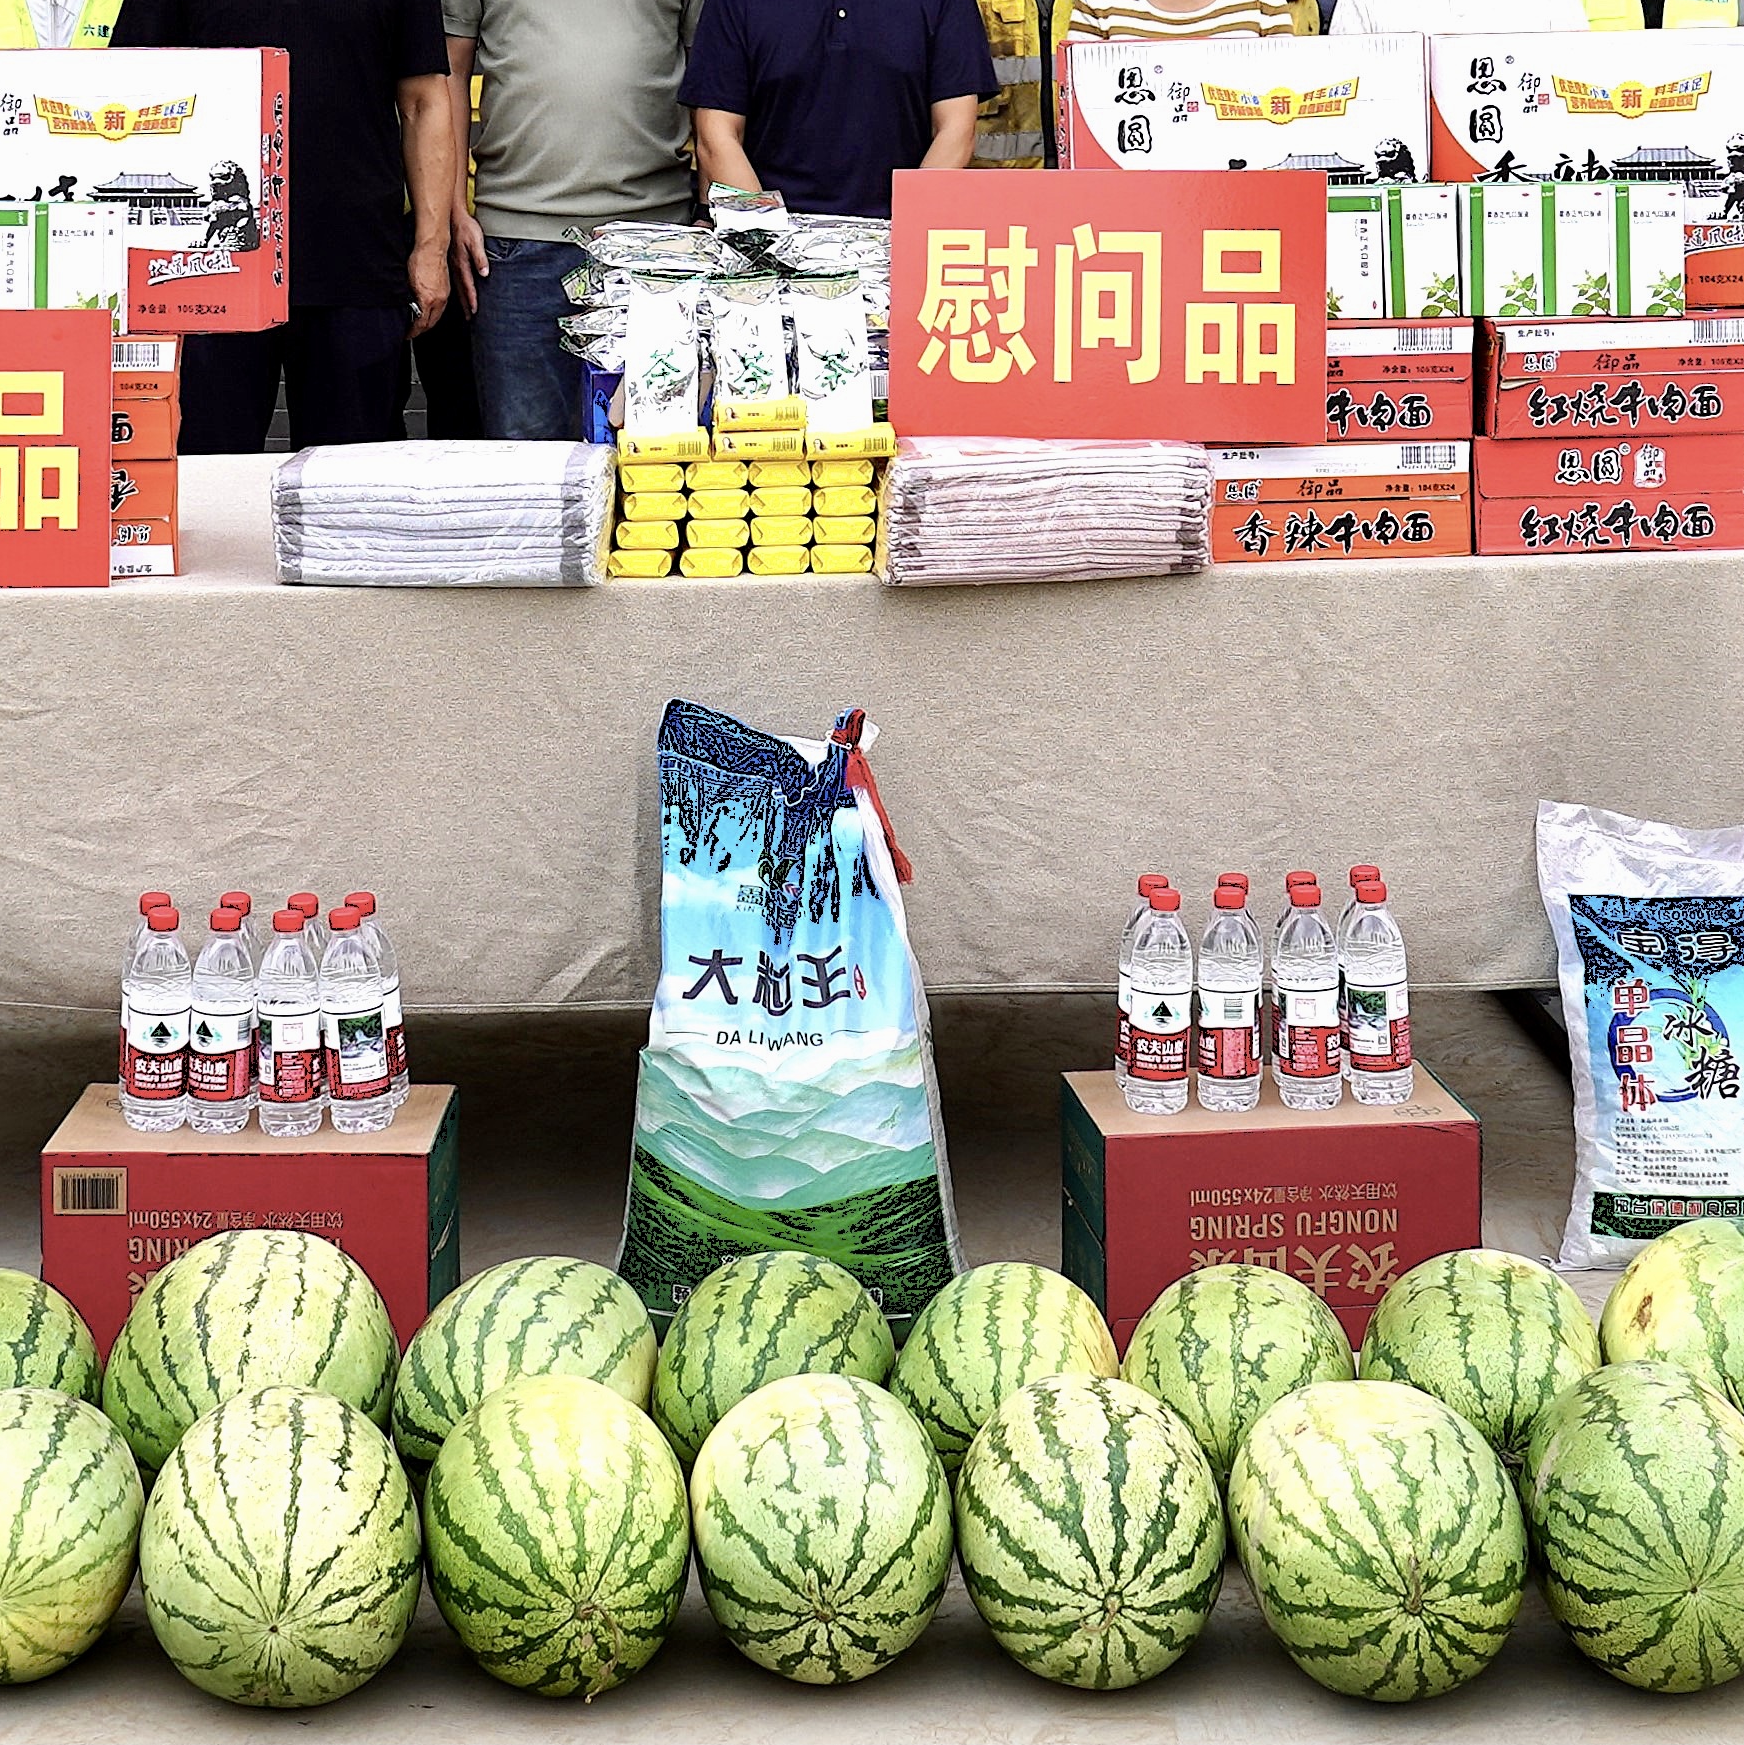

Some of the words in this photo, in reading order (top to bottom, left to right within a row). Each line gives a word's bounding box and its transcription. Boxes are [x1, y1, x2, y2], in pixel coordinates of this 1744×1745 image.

[916, 223, 1296, 385] 慰问品
[1529, 380, 1723, 429] 红烧牛肉面
[1233, 510, 1434, 557] 香辣牛肉面
[1520, 500, 1715, 549] 红烧牛肉面
[716, 1030, 743, 1047] DA
[747, 1029, 763, 1048] LI
[768, 1031, 825, 1051] WANG
[1612, 978, 1657, 1113] 单晶体
[1662, 1005, 1742, 1101] 冰糖
[1189, 1213, 1285, 1240] SPRING
[1296, 1208, 1399, 1238] NONGFU
